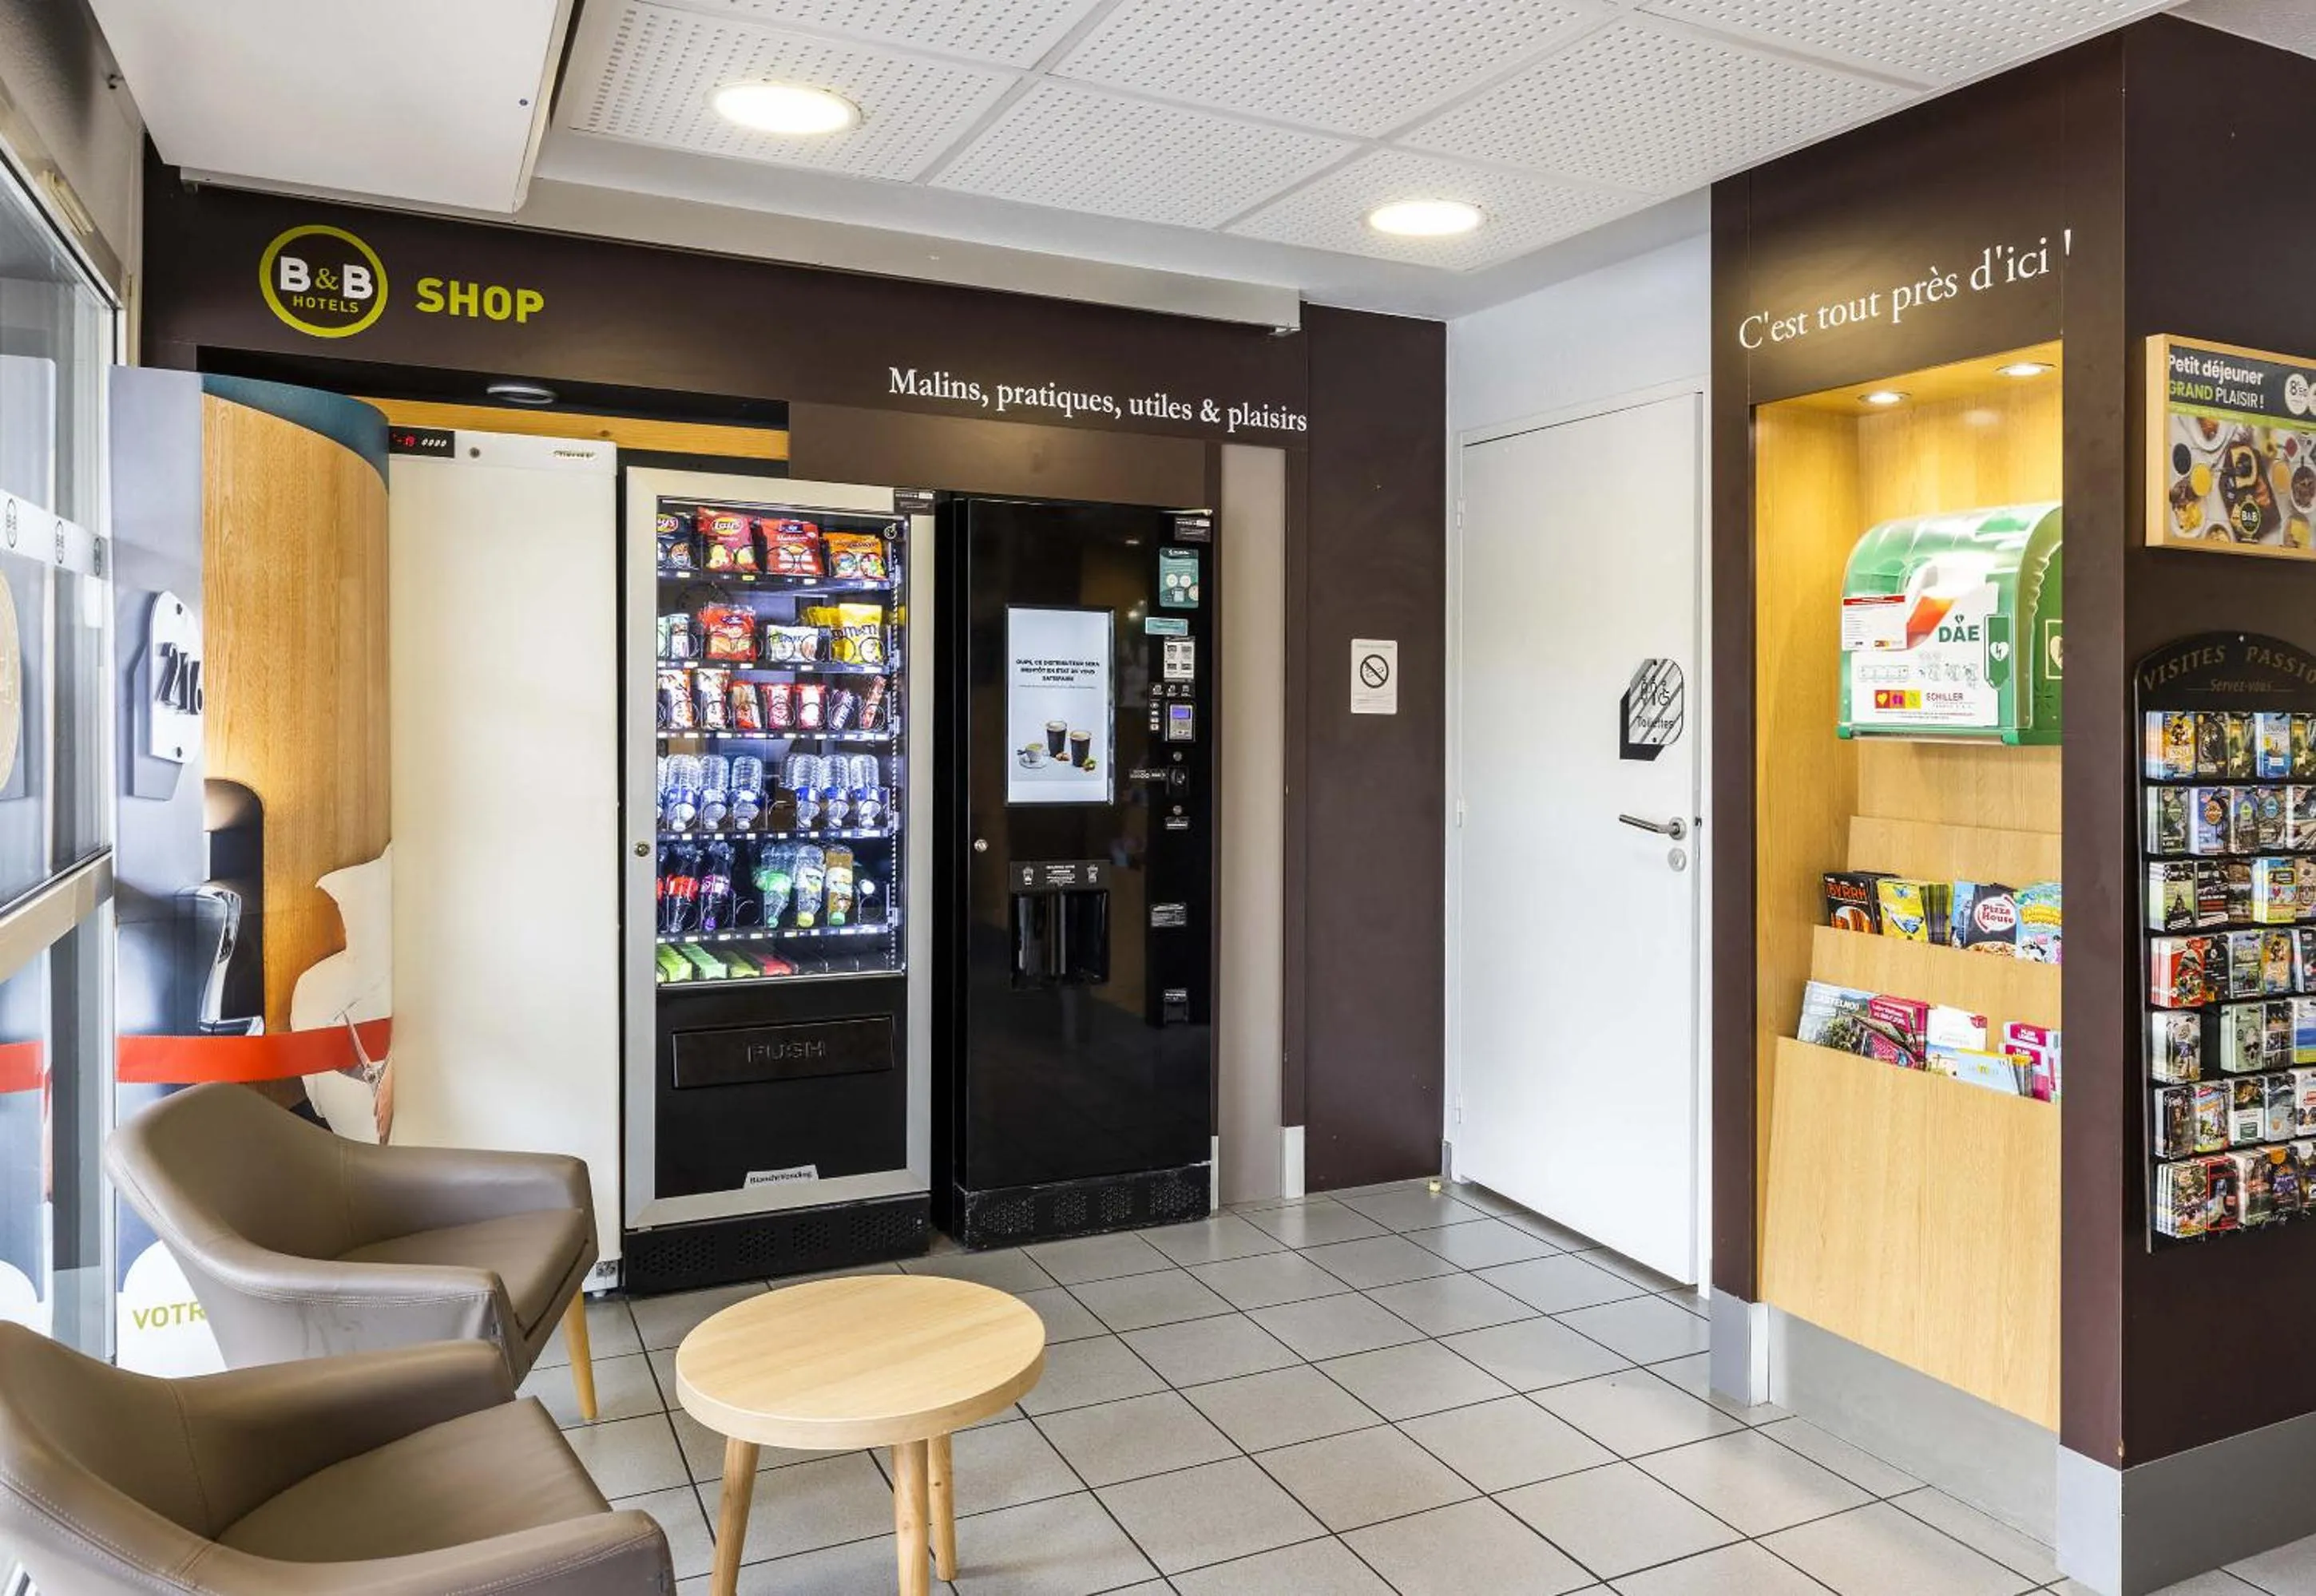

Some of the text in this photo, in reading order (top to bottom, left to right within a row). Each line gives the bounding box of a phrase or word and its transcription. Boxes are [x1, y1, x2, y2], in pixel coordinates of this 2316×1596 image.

[292, 295, 359, 314] HOTELS
[414, 276, 545, 324] SHOP
[1738, 311, 1809, 349] C'est
[1817, 291, 1881, 331] tout
[1891, 265, 1958, 324] près
[1969, 236, 2050, 291] d'ici
[2169, 354, 2264, 385] Petit déjeuner
[888, 366, 1308, 433] Malins, pratiques, utiles & plaisirs
[2169, 380, 2213, 400] GRAND
[2215, 386, 2258, 409] PLAISIR
[1937, 625, 1981, 644] DAE
[2143, 645, 2226, 691] VISITES
[1982, 904, 2011, 915] Pizza
[1982, 912, 2014, 924] House
[748, 1040, 824, 1063] PUSH
